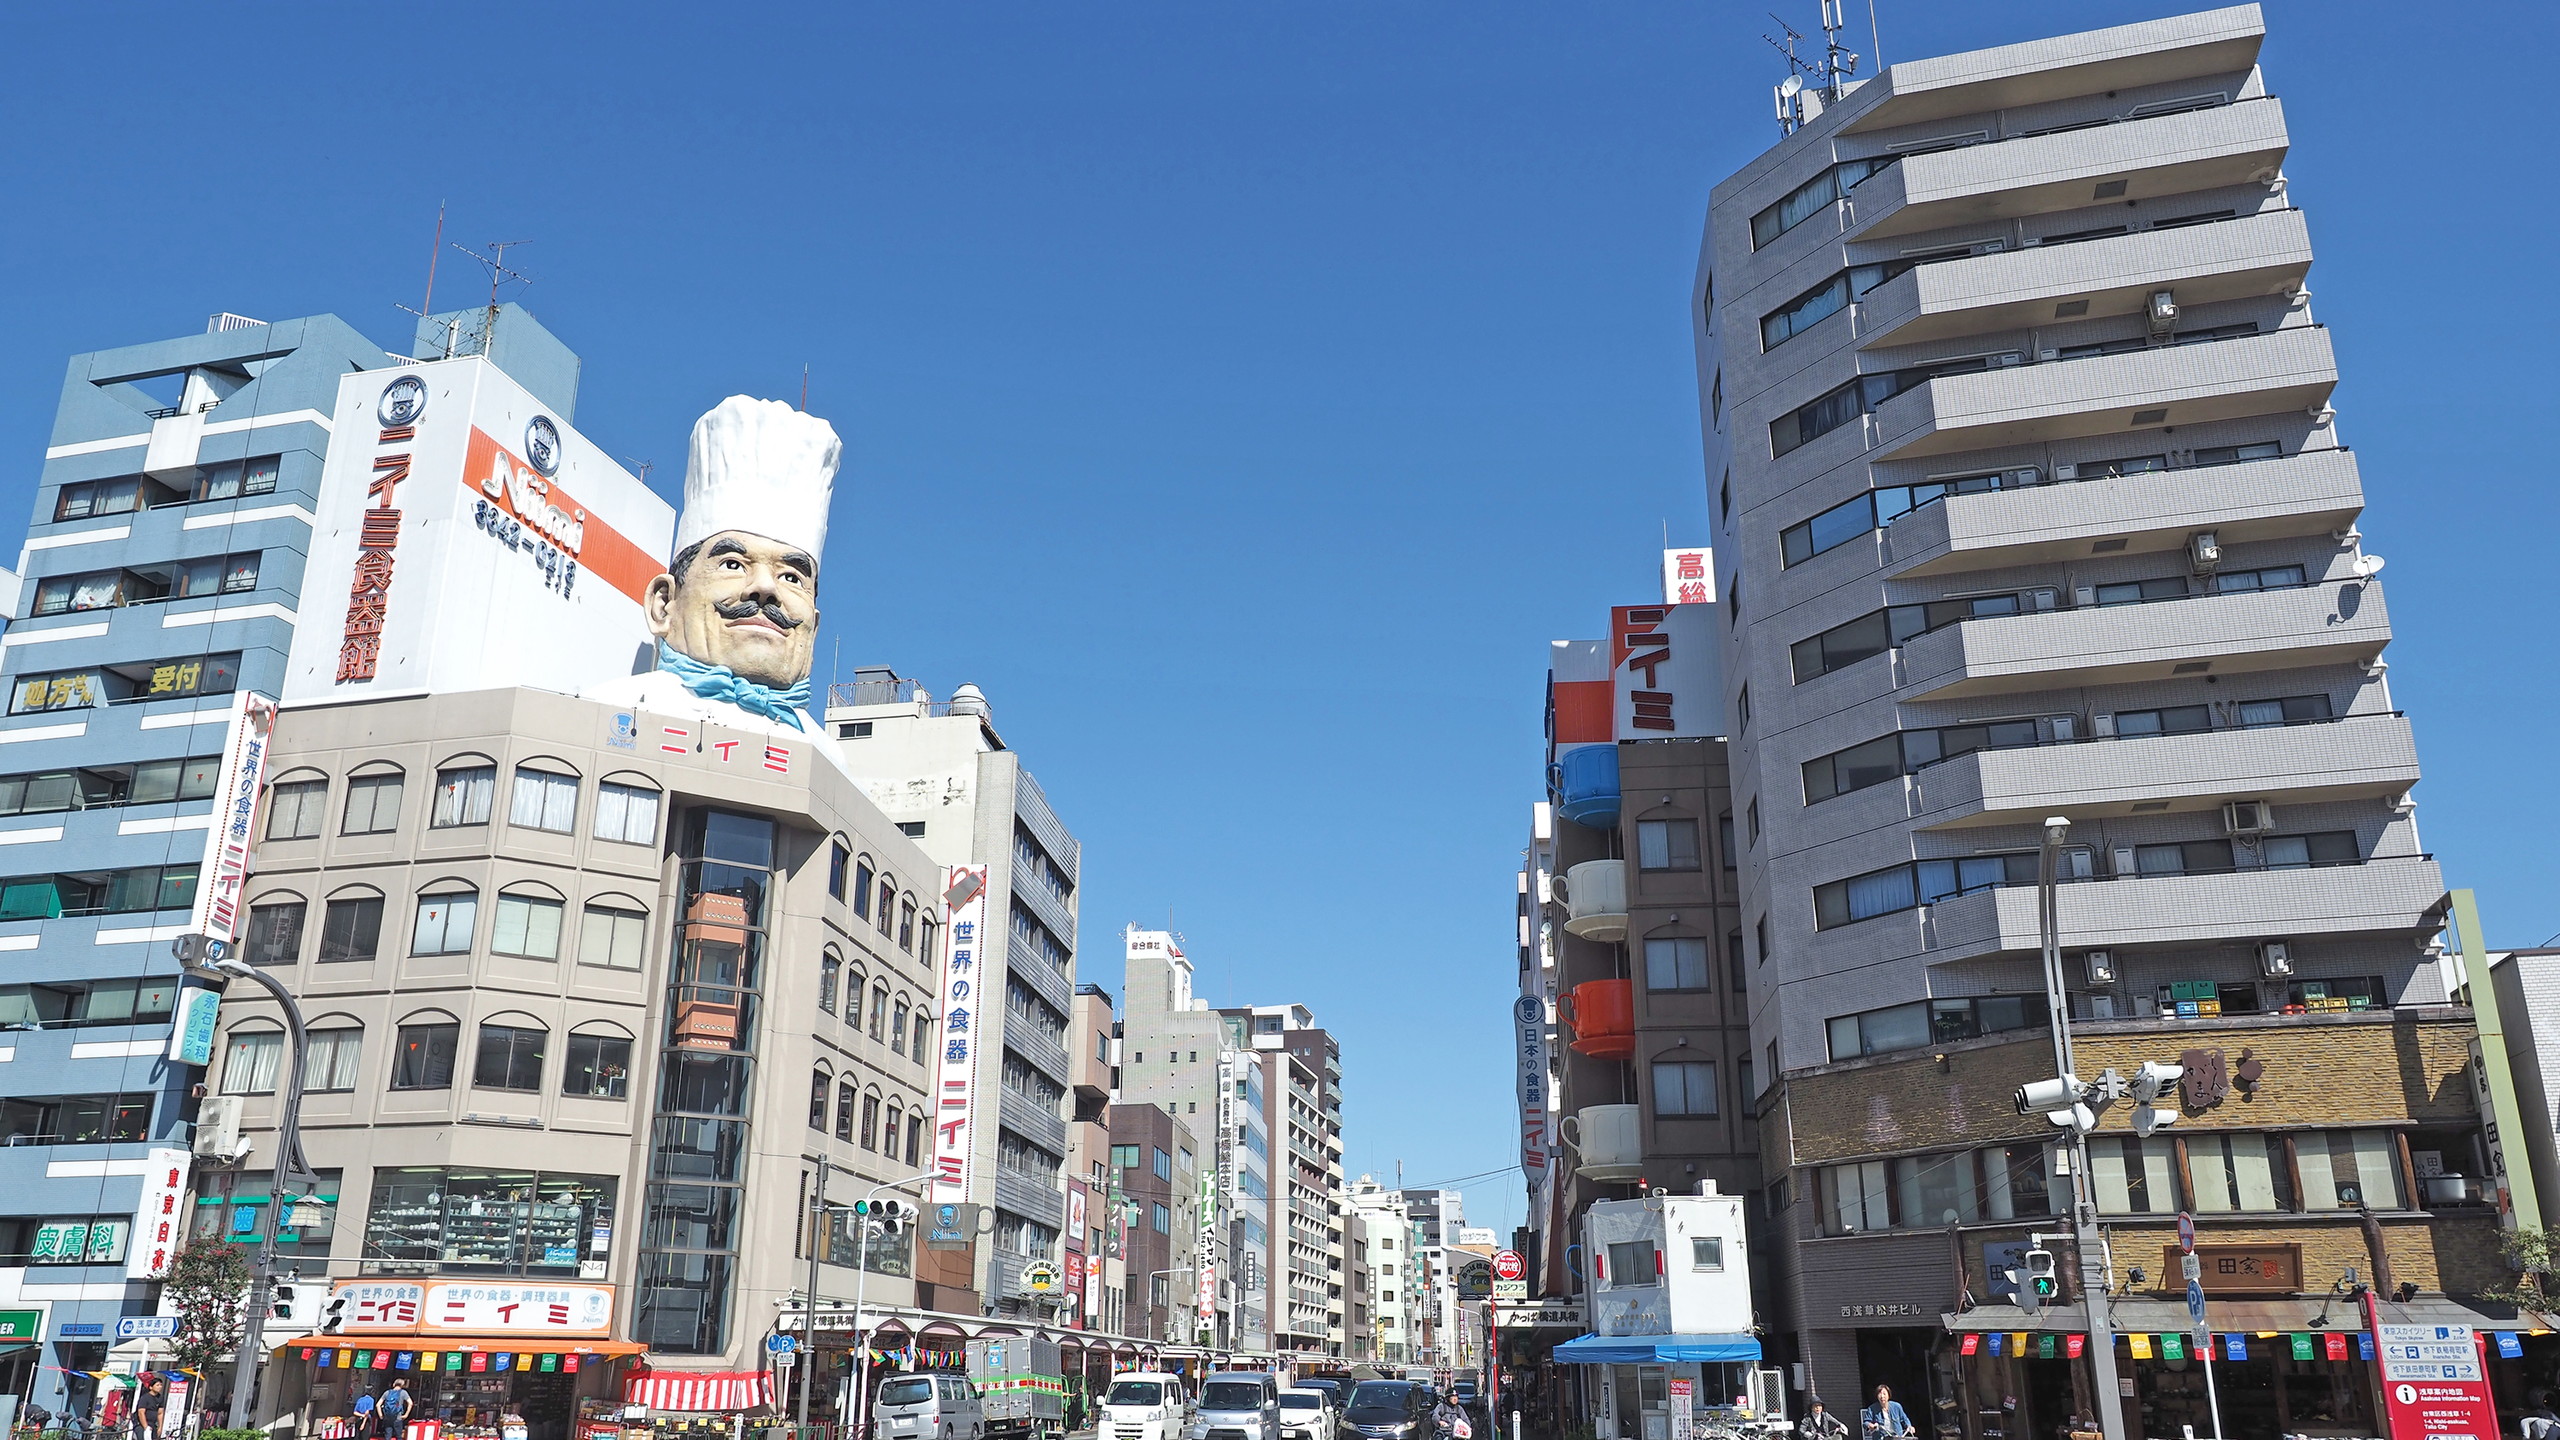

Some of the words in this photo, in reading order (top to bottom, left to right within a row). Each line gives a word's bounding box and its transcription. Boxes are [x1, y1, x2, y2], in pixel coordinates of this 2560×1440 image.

[481, 451, 585, 557] Niimi
[336, 425, 415, 683] ニイミ食器館
[25, 674, 93, 706] 処方せん
[150, 662, 201, 693] 受付
[1628, 610, 1674, 731] ニイミ
[661, 727, 790, 773] ニイミ
[232, 739, 262, 837] 世界の食器
[214, 844, 244, 926] ニイミ
[946, 920, 975, 1061] 世界の食器
[184, 1008, 199, 1056] クリニック
[194, 994, 216, 1060] 永石歯科
[1524, 1029, 1540, 1102] 日本の食器
[938, 1081, 967, 1184] ニイミ
[1525, 1108, 1545, 1168] ニイミ
[32, 1223, 115, 1258] 皮膚科
[928, 1227, 963, 1240] Niimi
[1108, 1203, 1119, 1253] サイトウ
[1461, 1231, 1488, 1242] カジワラ
[1499, 1261, 1518, 1272] 消火栓
[361, 1287, 419, 1299] 世界の食器
[447, 1288, 571, 1303] 世界の食器・調理器具
[137, 1319, 169, 1329] 浅草通り
[357, 1300, 416, 1322] ニイミ
[443, 1302, 569, 1324] ニイミ
[581, 1315, 603, 1324] Niimi
[1510, 1311, 1579, 1322] かっぱ橋道具街
[1840, 1303, 1921, 1317] 西浅草松井ビル
[0, 1323, 15, 1335] ER
[2383, 1327, 2431, 1335] 東京スカイツリー
[2423, 1346, 2469, 1354] 地下鉄稲荷町駅
[2393, 1365, 2438, 1374] 地下鉄田原町駅
